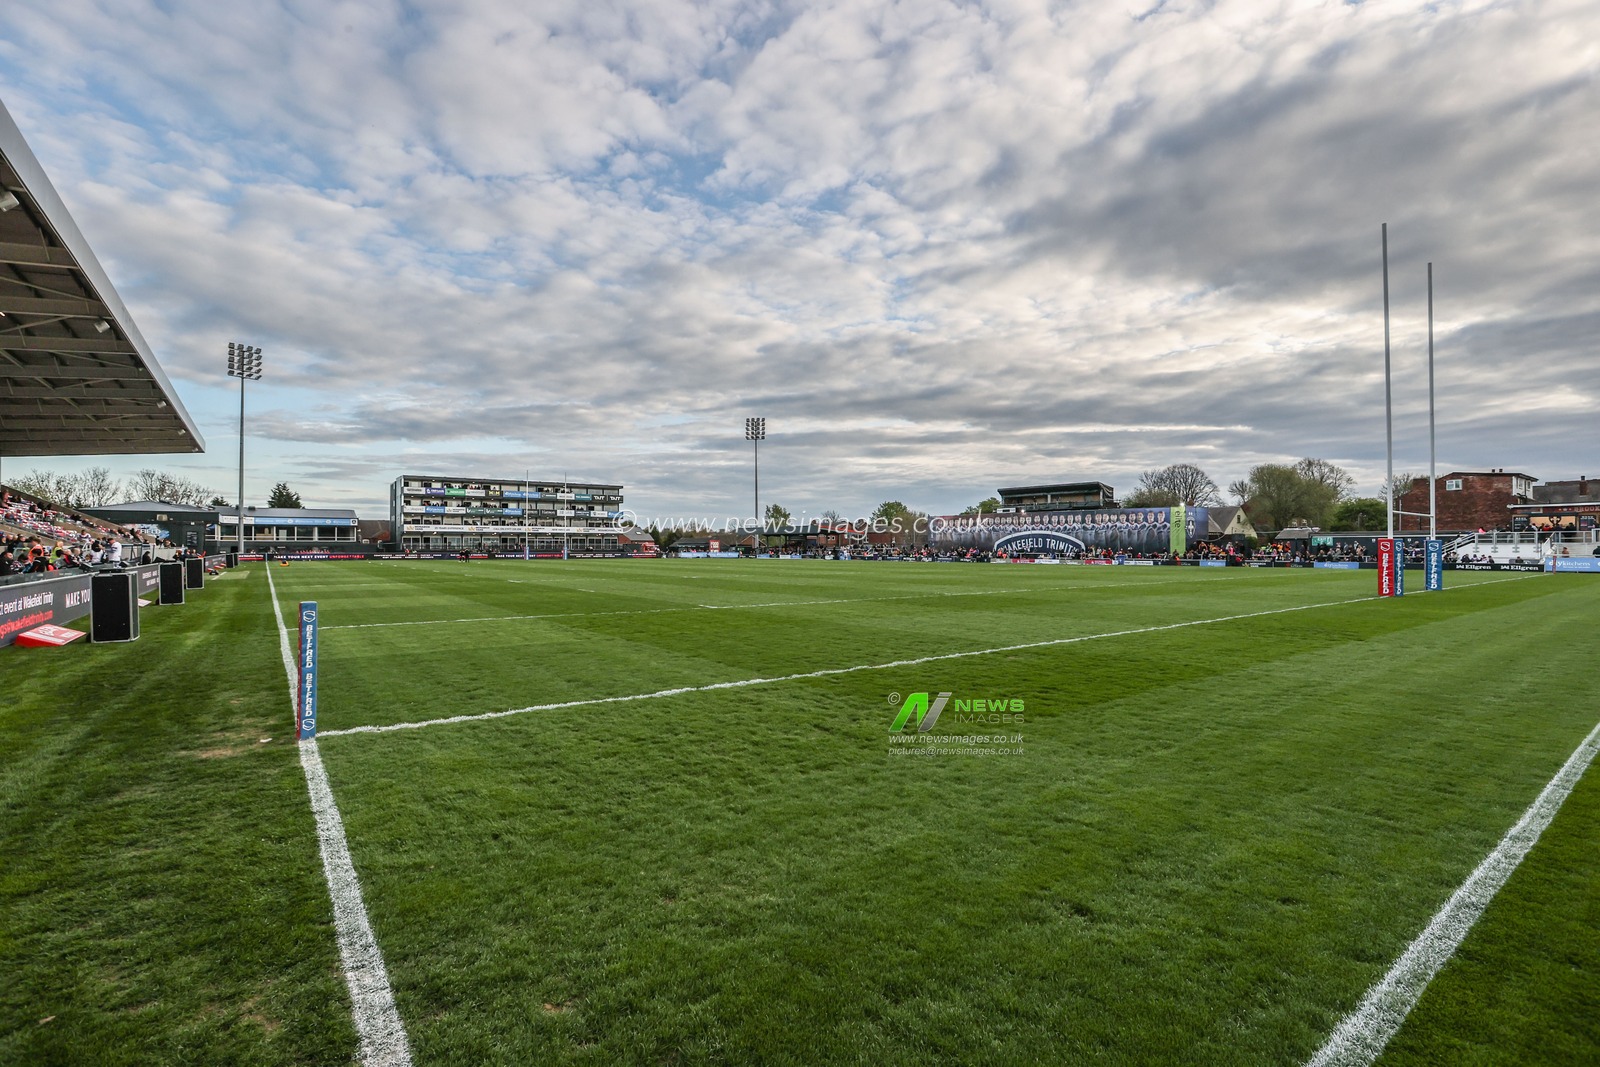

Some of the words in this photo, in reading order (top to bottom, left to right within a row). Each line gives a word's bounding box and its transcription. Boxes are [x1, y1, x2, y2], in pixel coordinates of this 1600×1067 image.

[4, 598, 17, 614] event
[18, 597, 23, 611] at
[23, 593, 43, 610] Wakefield
[43, 591, 54, 606] Trinity
[65, 590, 80, 609] MAKE
[81, 588, 91, 604] YOU
[305, 624, 314, 669] BETFRED
[305, 672, 313, 717] BETFRED
